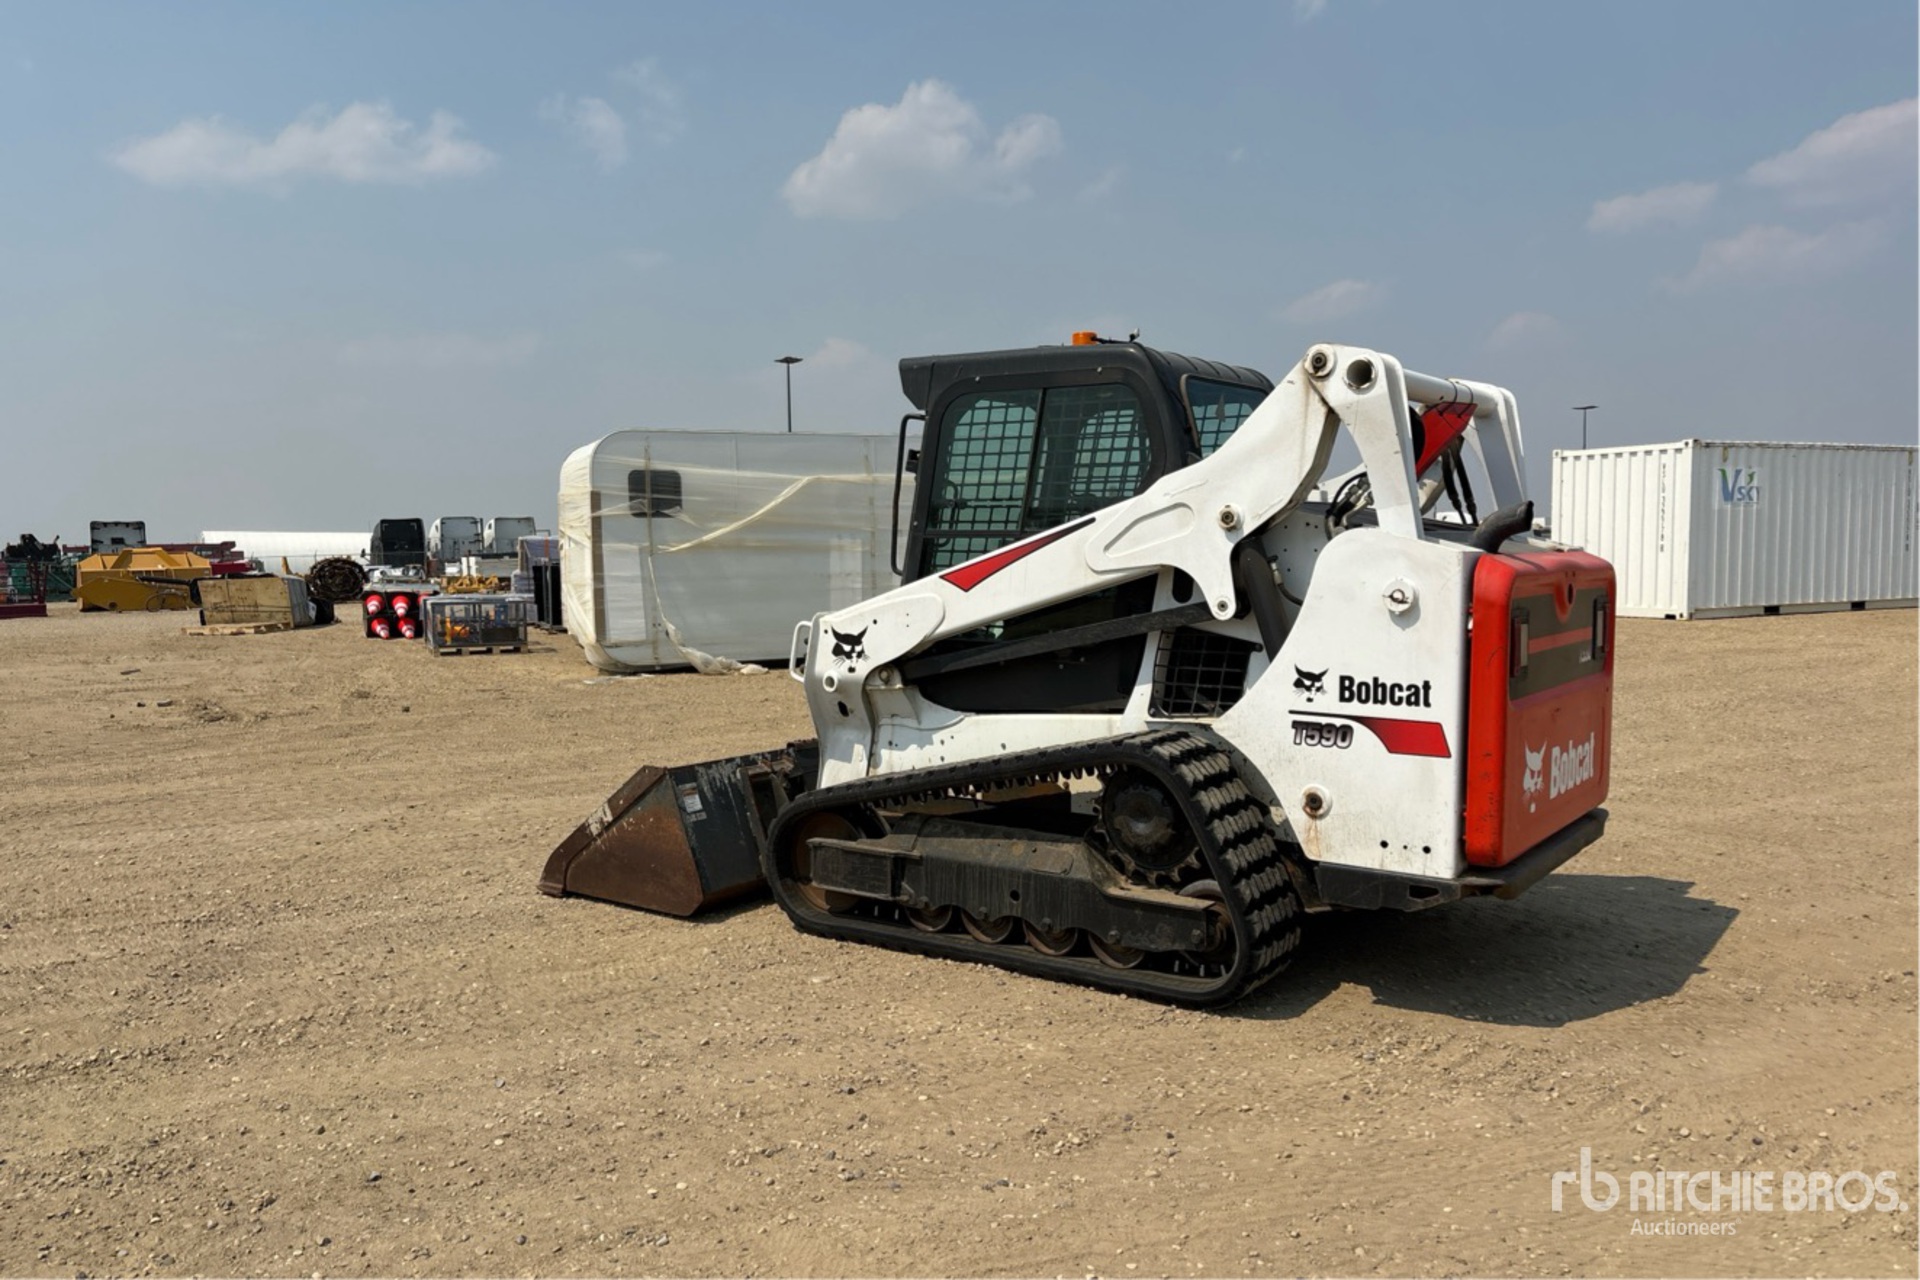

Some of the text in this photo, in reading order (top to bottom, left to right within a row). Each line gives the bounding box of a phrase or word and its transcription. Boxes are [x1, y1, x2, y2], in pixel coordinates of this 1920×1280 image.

[1338, 674, 1432, 708] Bobcat
[1291, 719, 1354, 750] T590
[1550, 731, 1595, 800] Bobcat
